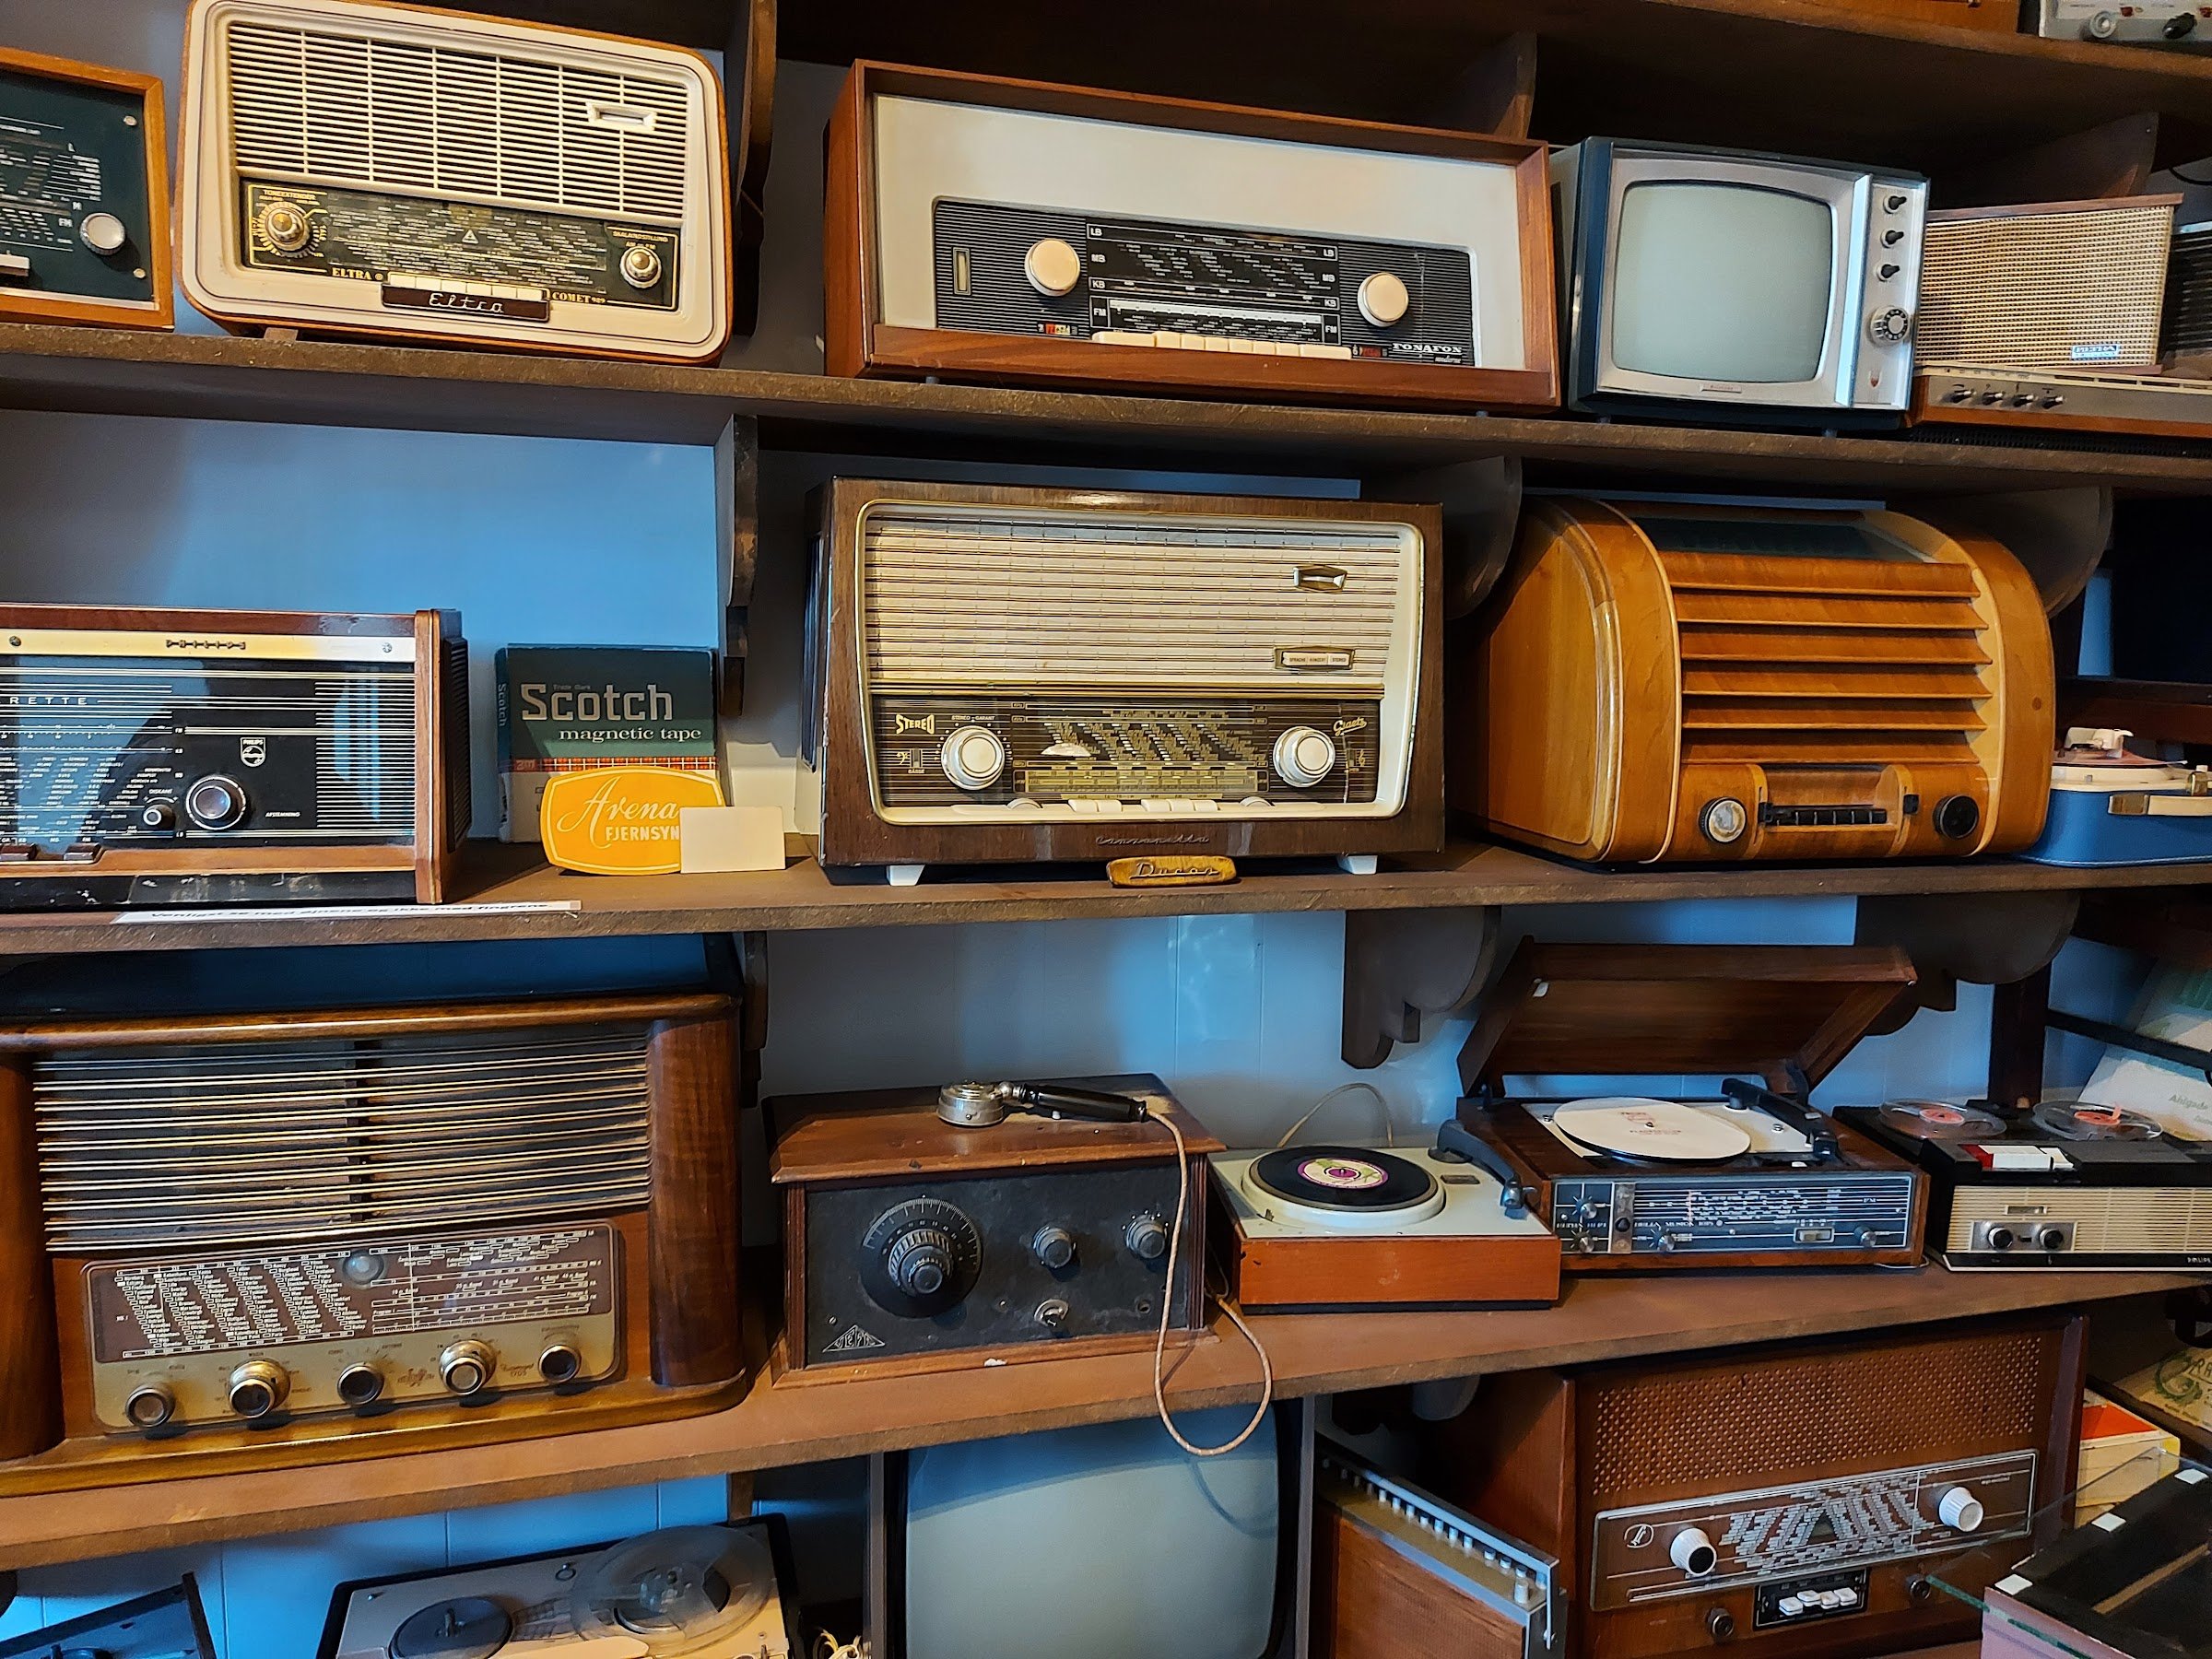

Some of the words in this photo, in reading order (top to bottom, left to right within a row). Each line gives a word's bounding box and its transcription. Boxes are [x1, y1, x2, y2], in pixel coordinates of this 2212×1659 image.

[58, 218, 73, 227] FM
[1090, 228, 1102, 236] LB
[1091, 253, 1106, 263] MB
[332, 267, 372, 280] ELTRA
[1322, 274, 1335, 282] MB
[1092, 280, 1106, 288] KB
[428, 292, 505, 313] Eltra
[552, 291, 591, 303] COMET
[1093, 308, 1107, 316] FM
[1325, 325, 1337, 334] FM
[166, 640, 246, 650] PHILIPS
[0, 697, 88, 705] RETTE
[498, 683, 507, 727] Scotch
[521, 684, 673, 721] Scotch
[896, 714, 935, 735] STEREO
[559, 726, 654, 743] magnetic
[660, 727, 701, 741] tape
[556, 775, 680, 850] Arena
[606, 825, 680, 841] FJERNSYN
